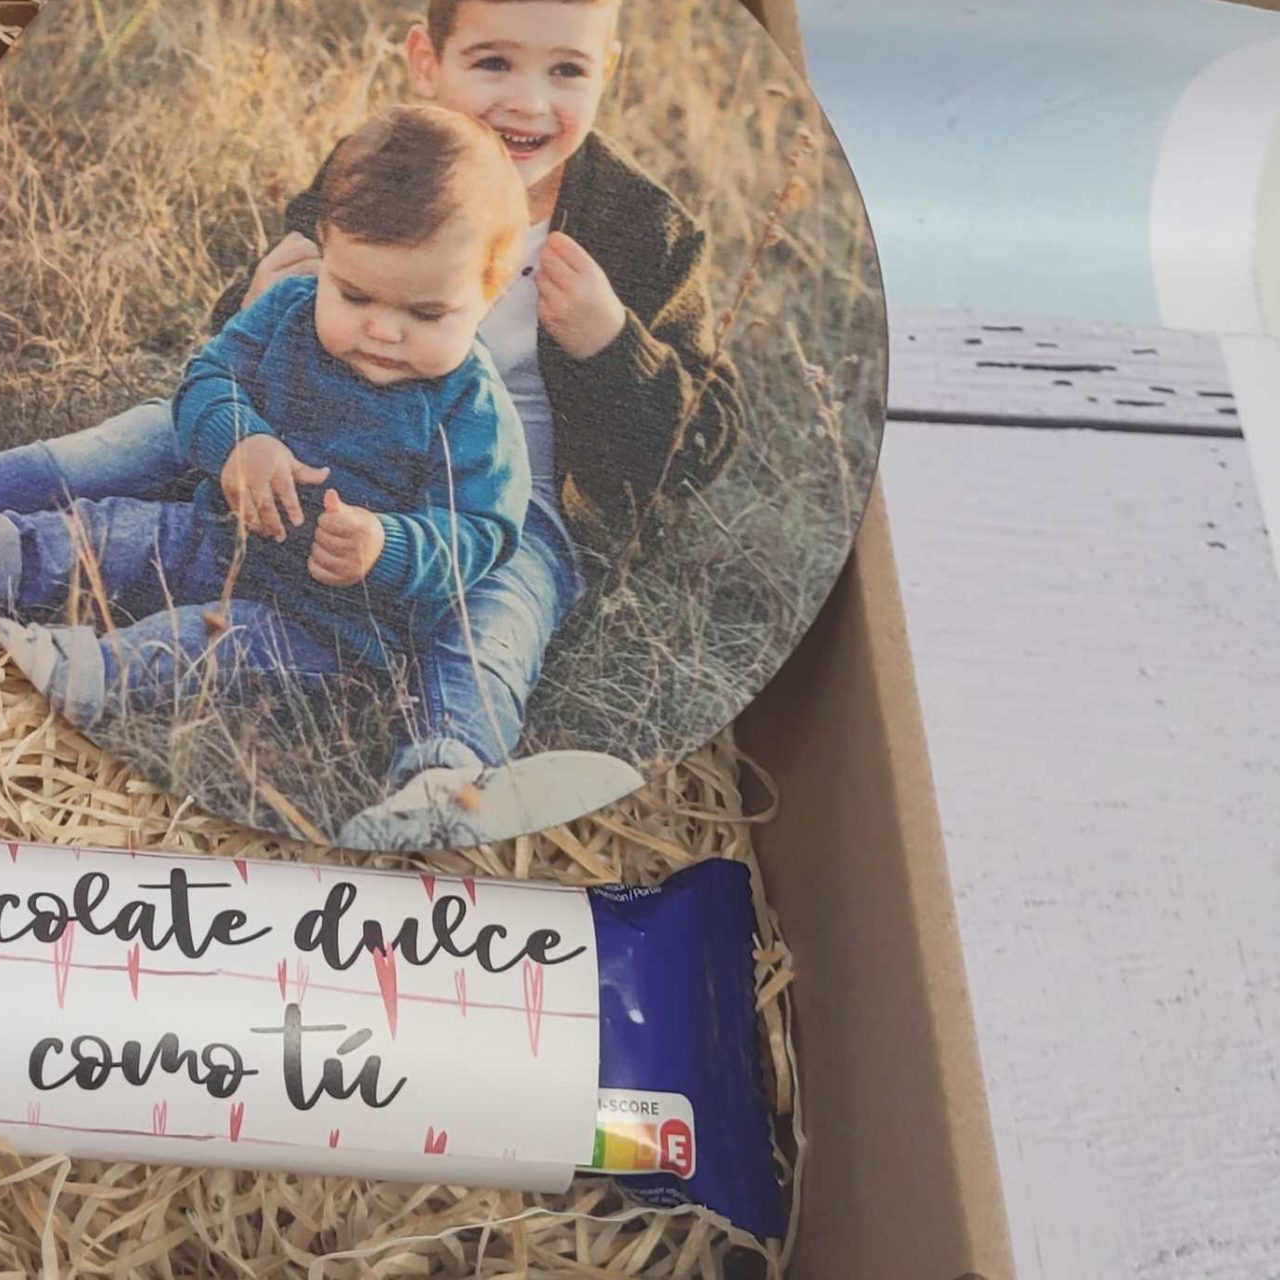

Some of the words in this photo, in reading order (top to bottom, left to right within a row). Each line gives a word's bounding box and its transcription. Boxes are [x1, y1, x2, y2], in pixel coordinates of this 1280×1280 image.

[293, 881, 588, 974] dulce
[28, 1032, 259, 1099] como
[250, 1002, 408, 1111] tú
[666, 1133, 688, 1168] E
